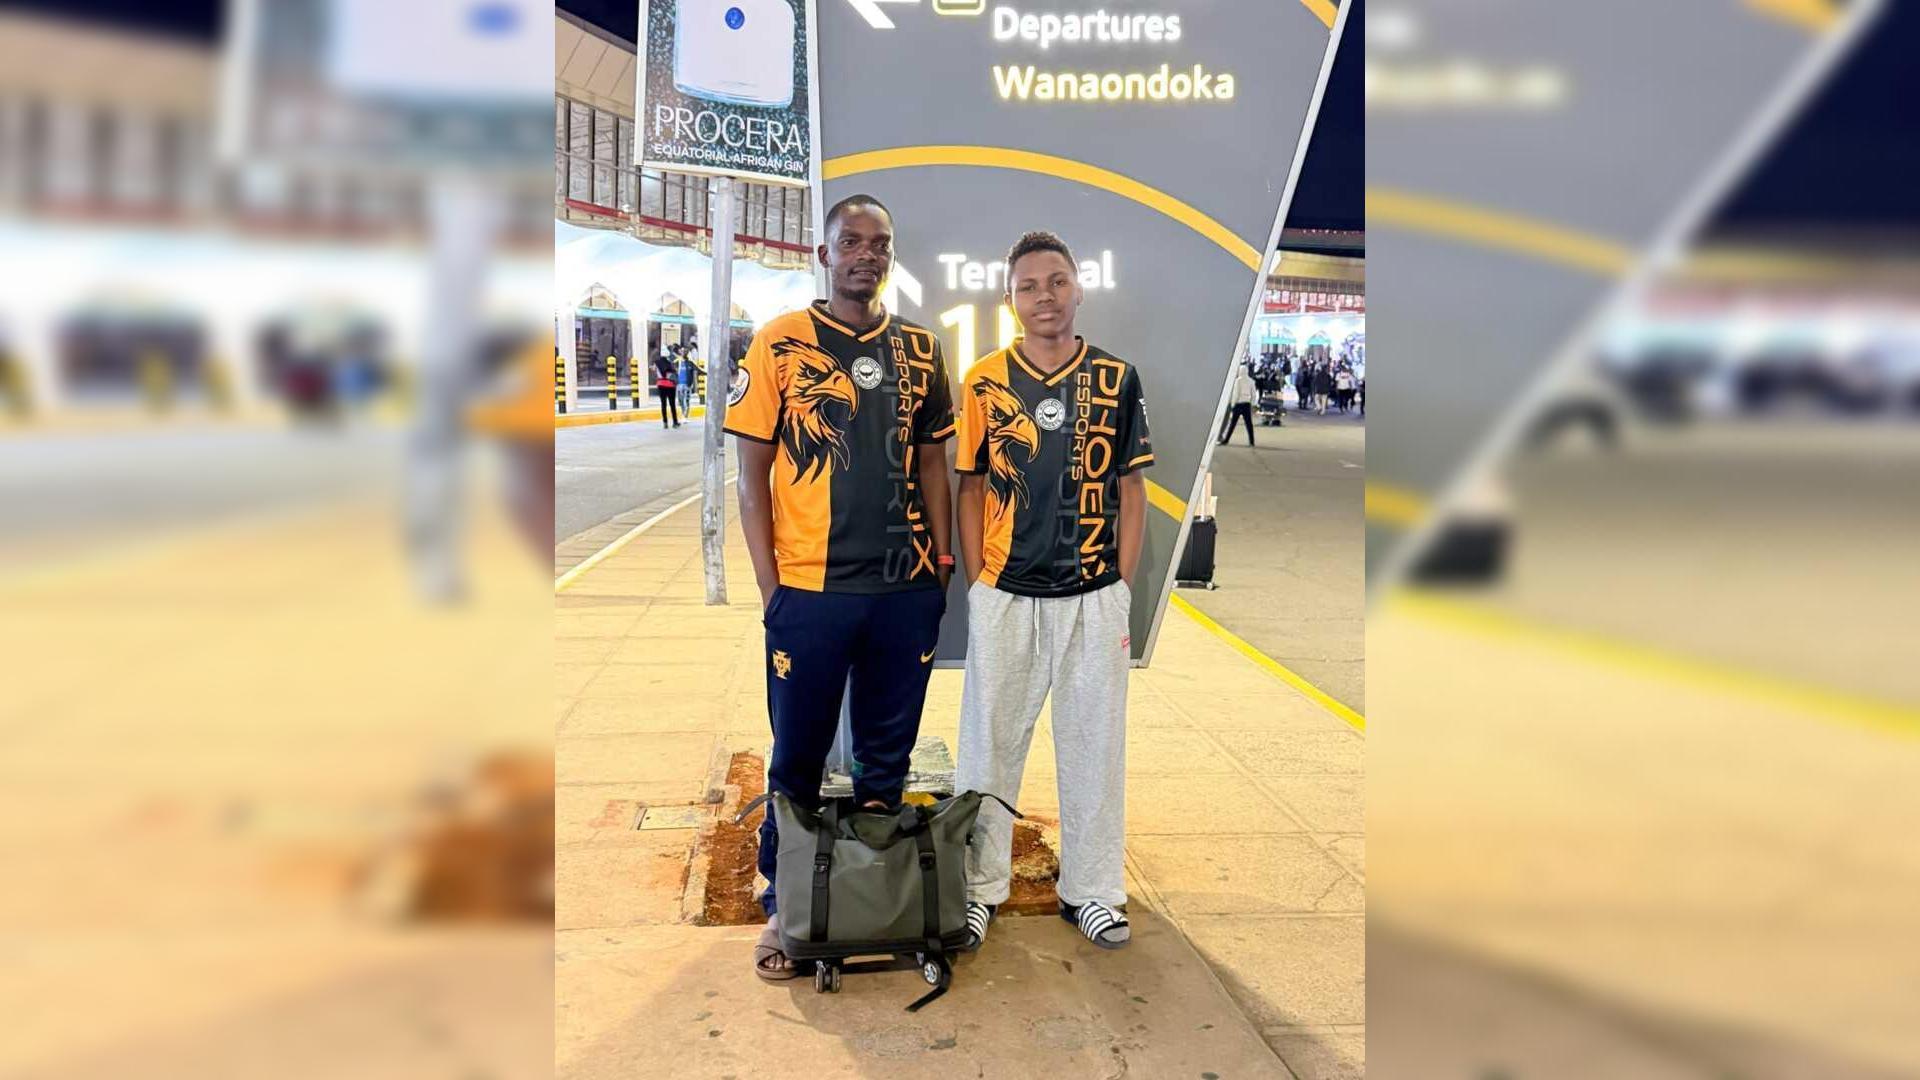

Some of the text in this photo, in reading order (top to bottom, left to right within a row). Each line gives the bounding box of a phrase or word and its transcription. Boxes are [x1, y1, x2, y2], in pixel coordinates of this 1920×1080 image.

[993, 6, 1181, 49] Departures
[992, 63, 1235, 99] Wanaondoka
[655, 103, 804, 156] PROCERA
[654, 143, 804, 173] EQUATORIAL AFRICAN GIN
[938, 250, 1115, 290] Teral
[890, 335, 914, 443] ESPORTS
[1071, 372, 1092, 481] ESPORTS
